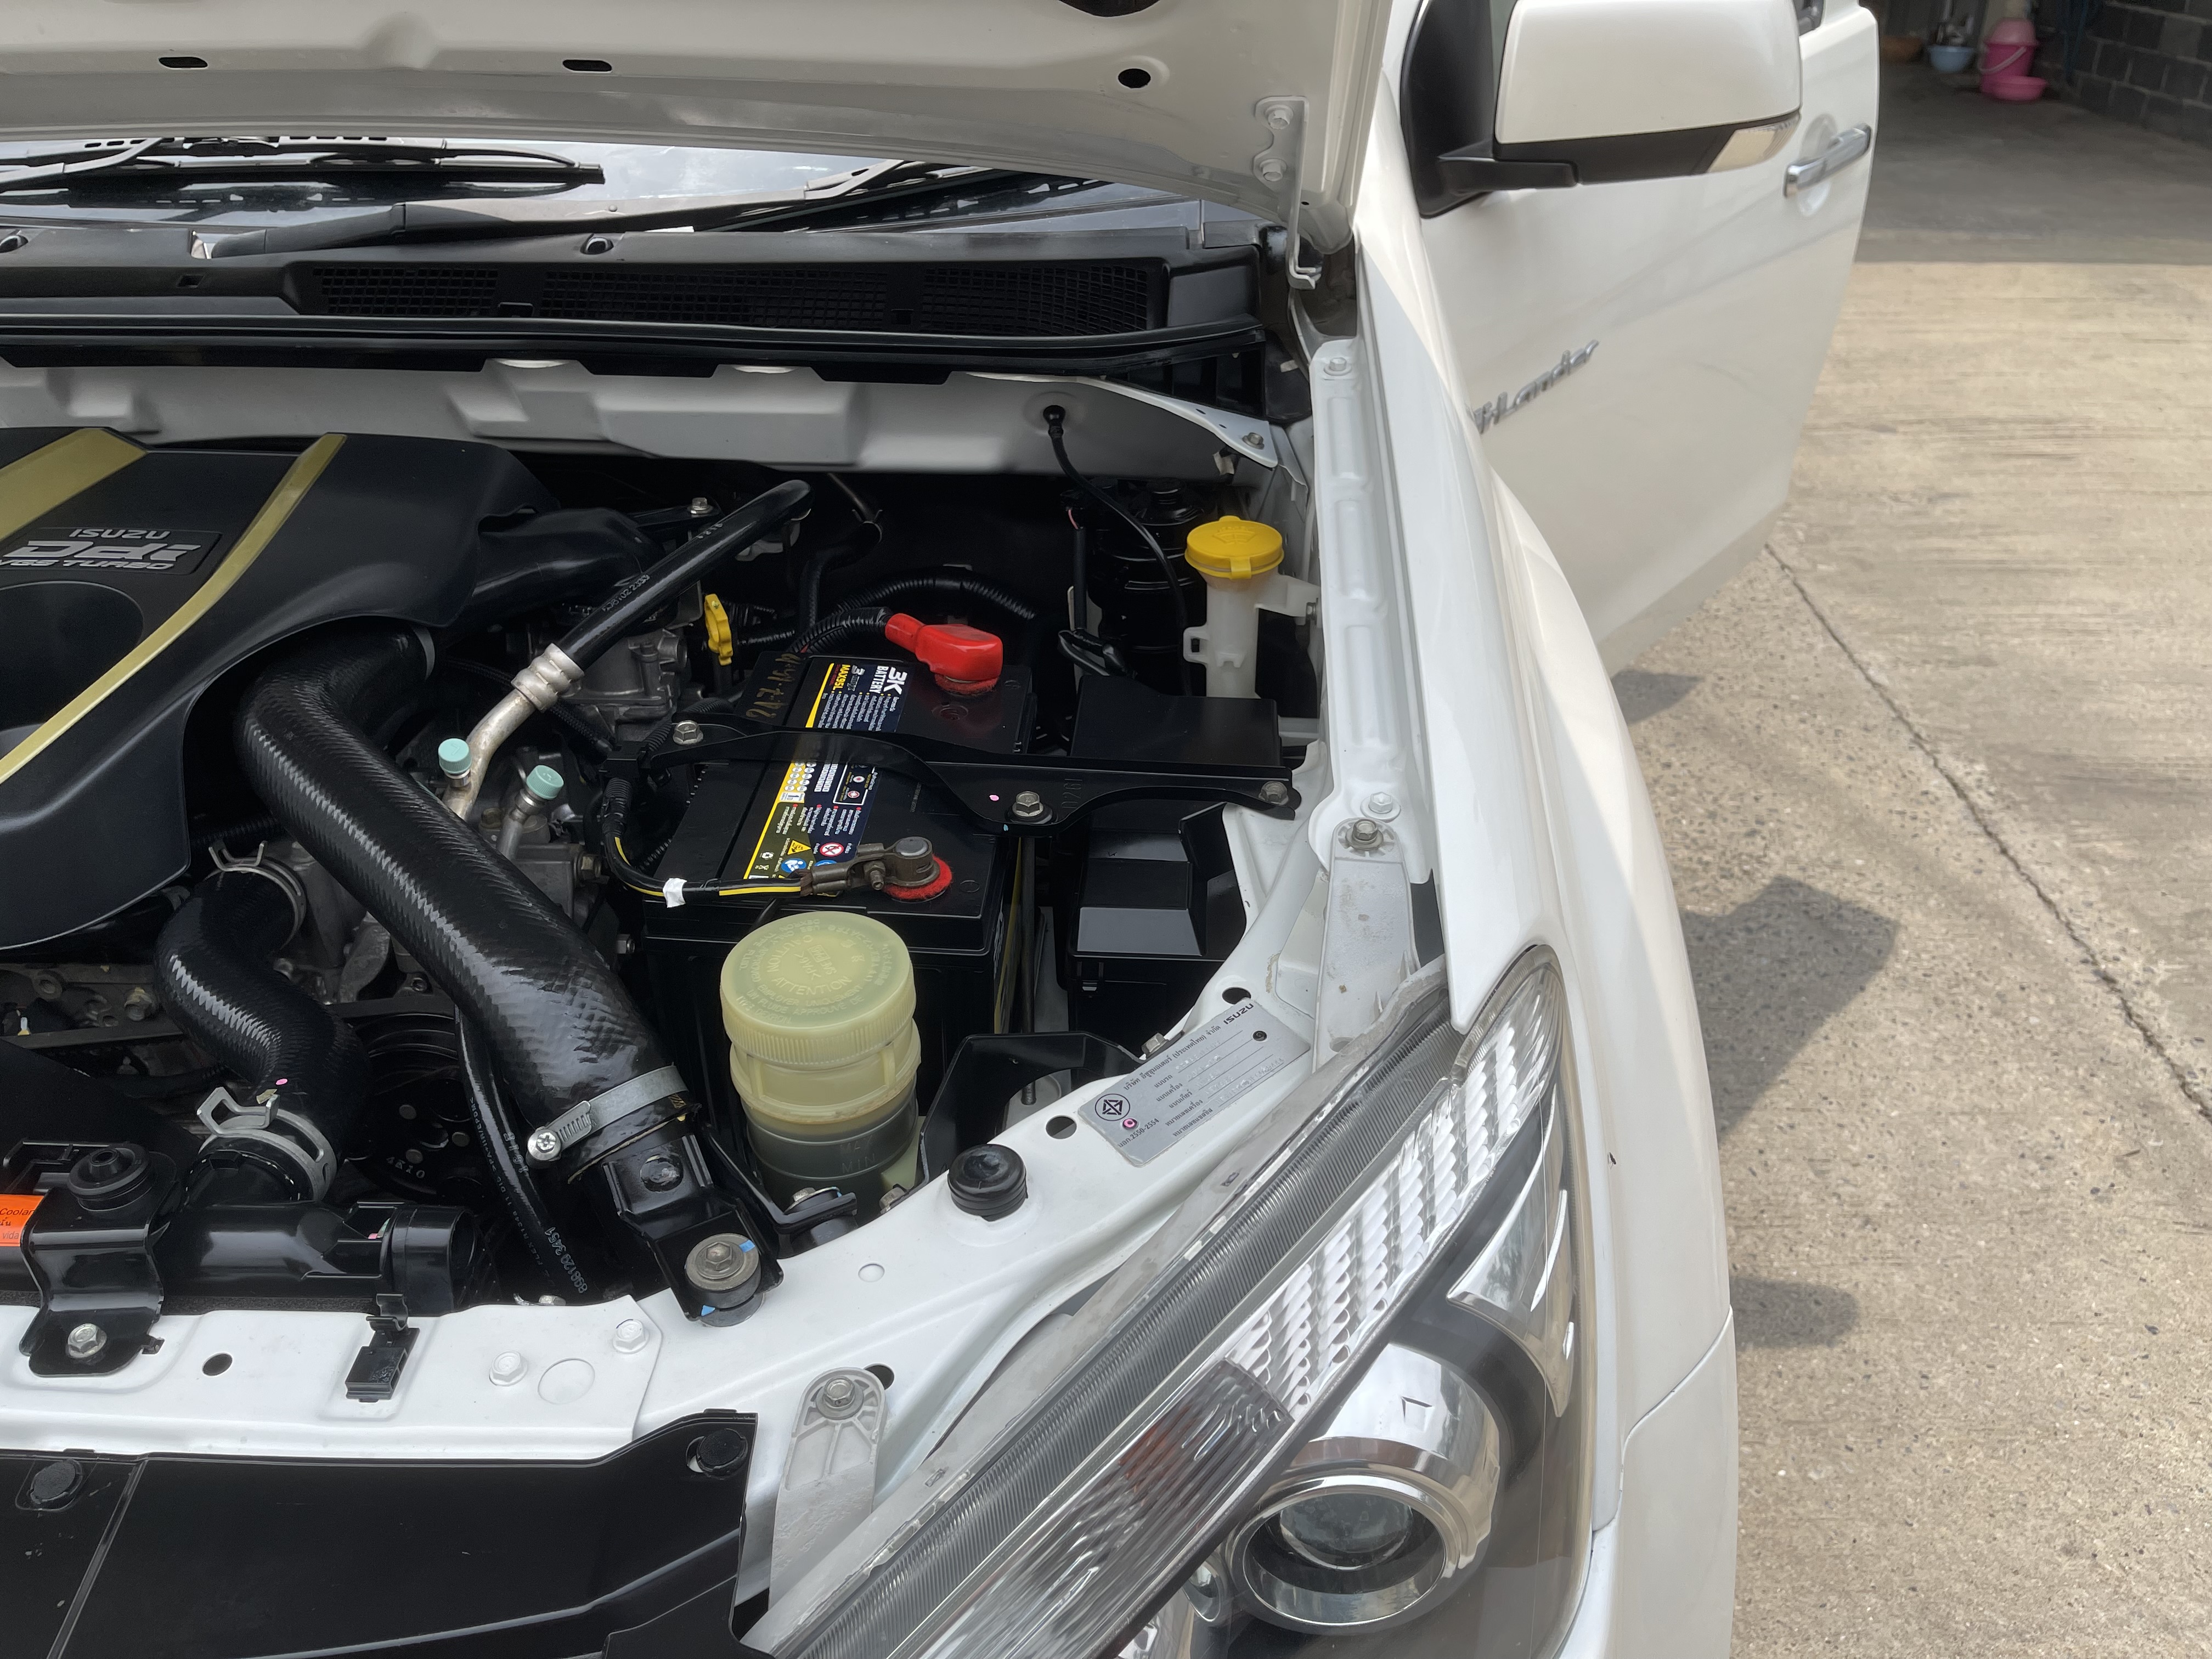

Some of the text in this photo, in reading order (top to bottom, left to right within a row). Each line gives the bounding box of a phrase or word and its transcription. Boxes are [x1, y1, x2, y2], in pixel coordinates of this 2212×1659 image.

[69, 528, 171, 539] ISUZU
[63, 560, 174, 569] TURBO
[833, 664, 850, 690] MAX95L
[869, 666, 888, 693] BATTERY
[883, 667, 908, 695] 3K
[758, 984, 864, 1007] EMPLOYER UNIQUEMENT
[771, 975, 852, 995] ATTENTION
[758, 997, 789, 1013] FLUIDE
[851, 996, 865, 1005] DE
[1223, 1003, 1254, 1025] ISUZU
[842, 1153, 877, 1173] MIN
[544, 1227, 588, 1294] 898129 3451
